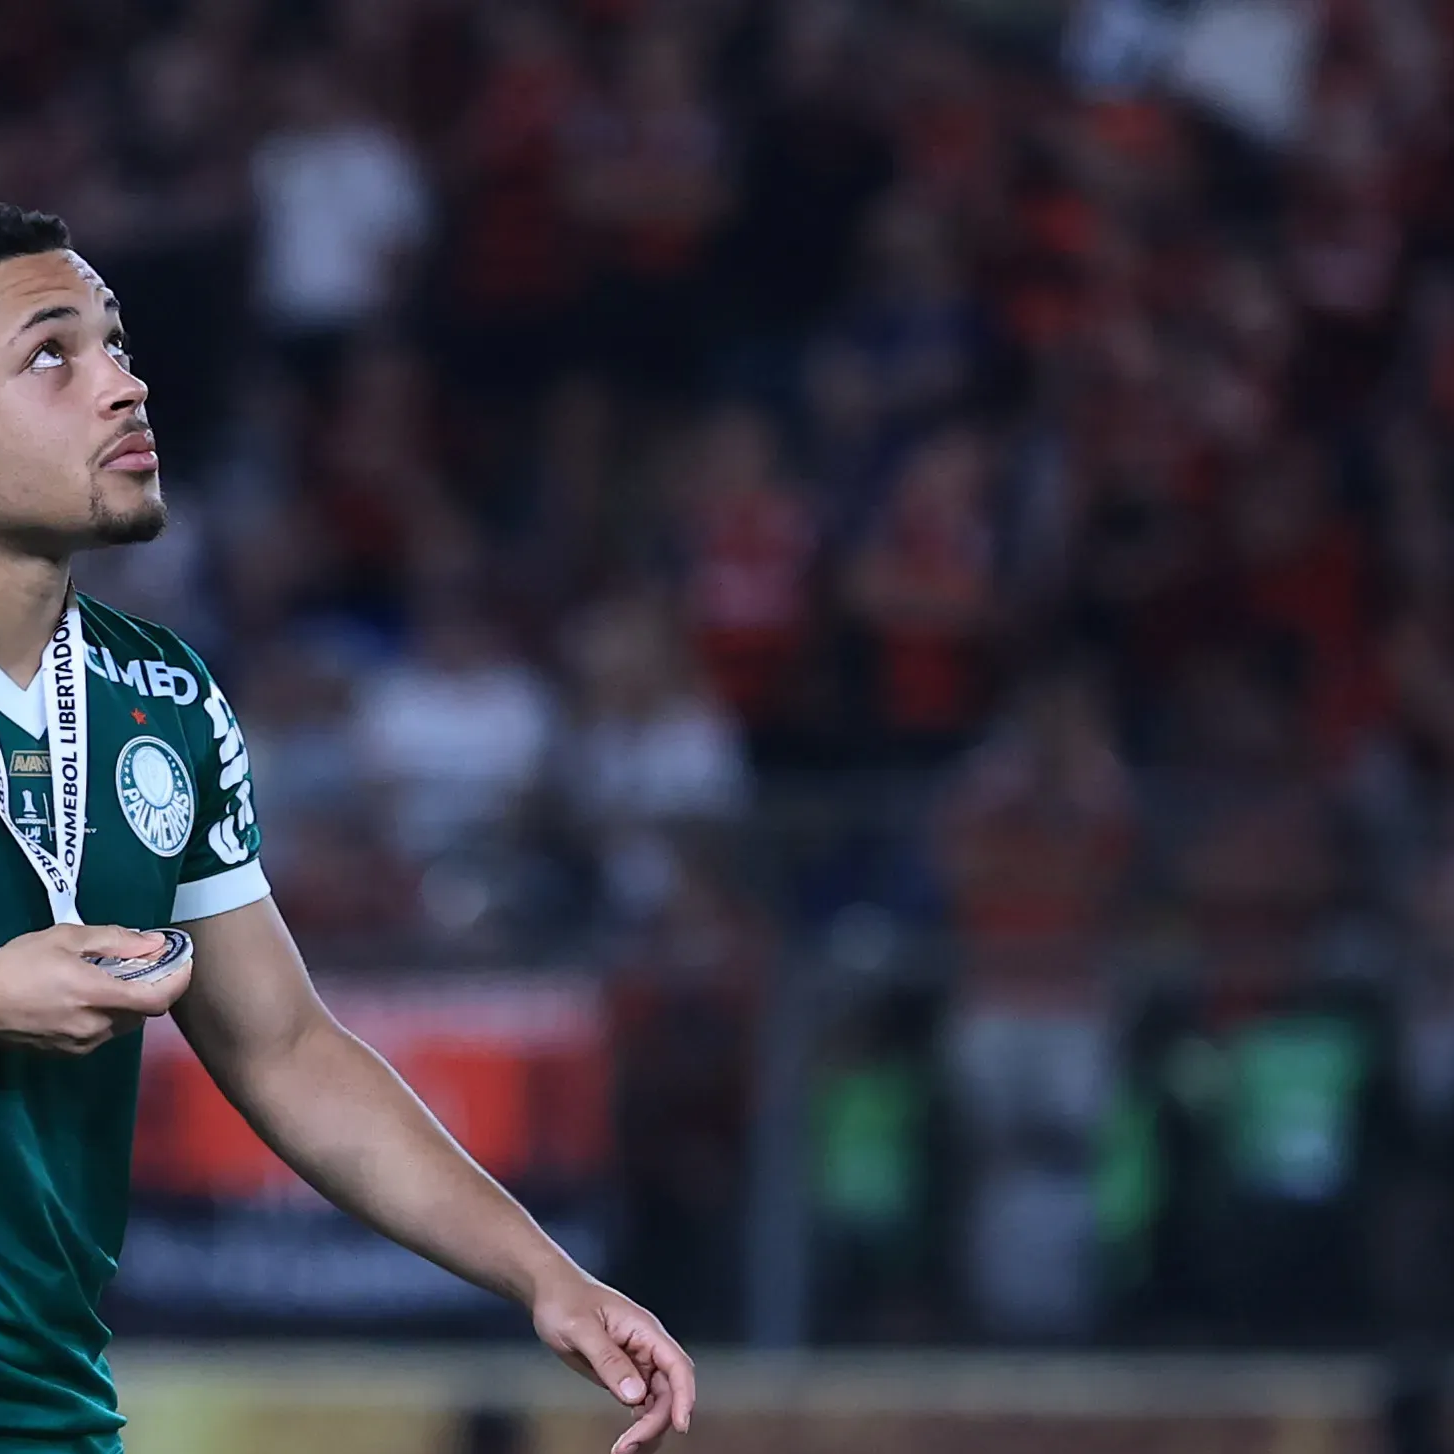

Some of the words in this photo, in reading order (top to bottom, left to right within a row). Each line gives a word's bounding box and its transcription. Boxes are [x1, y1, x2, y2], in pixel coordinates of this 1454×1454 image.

[83, 640, 198, 705] CIMED
[61, 751, 78, 873] ONMEBOL
[123, 788, 189, 851] PALMEIRAS
